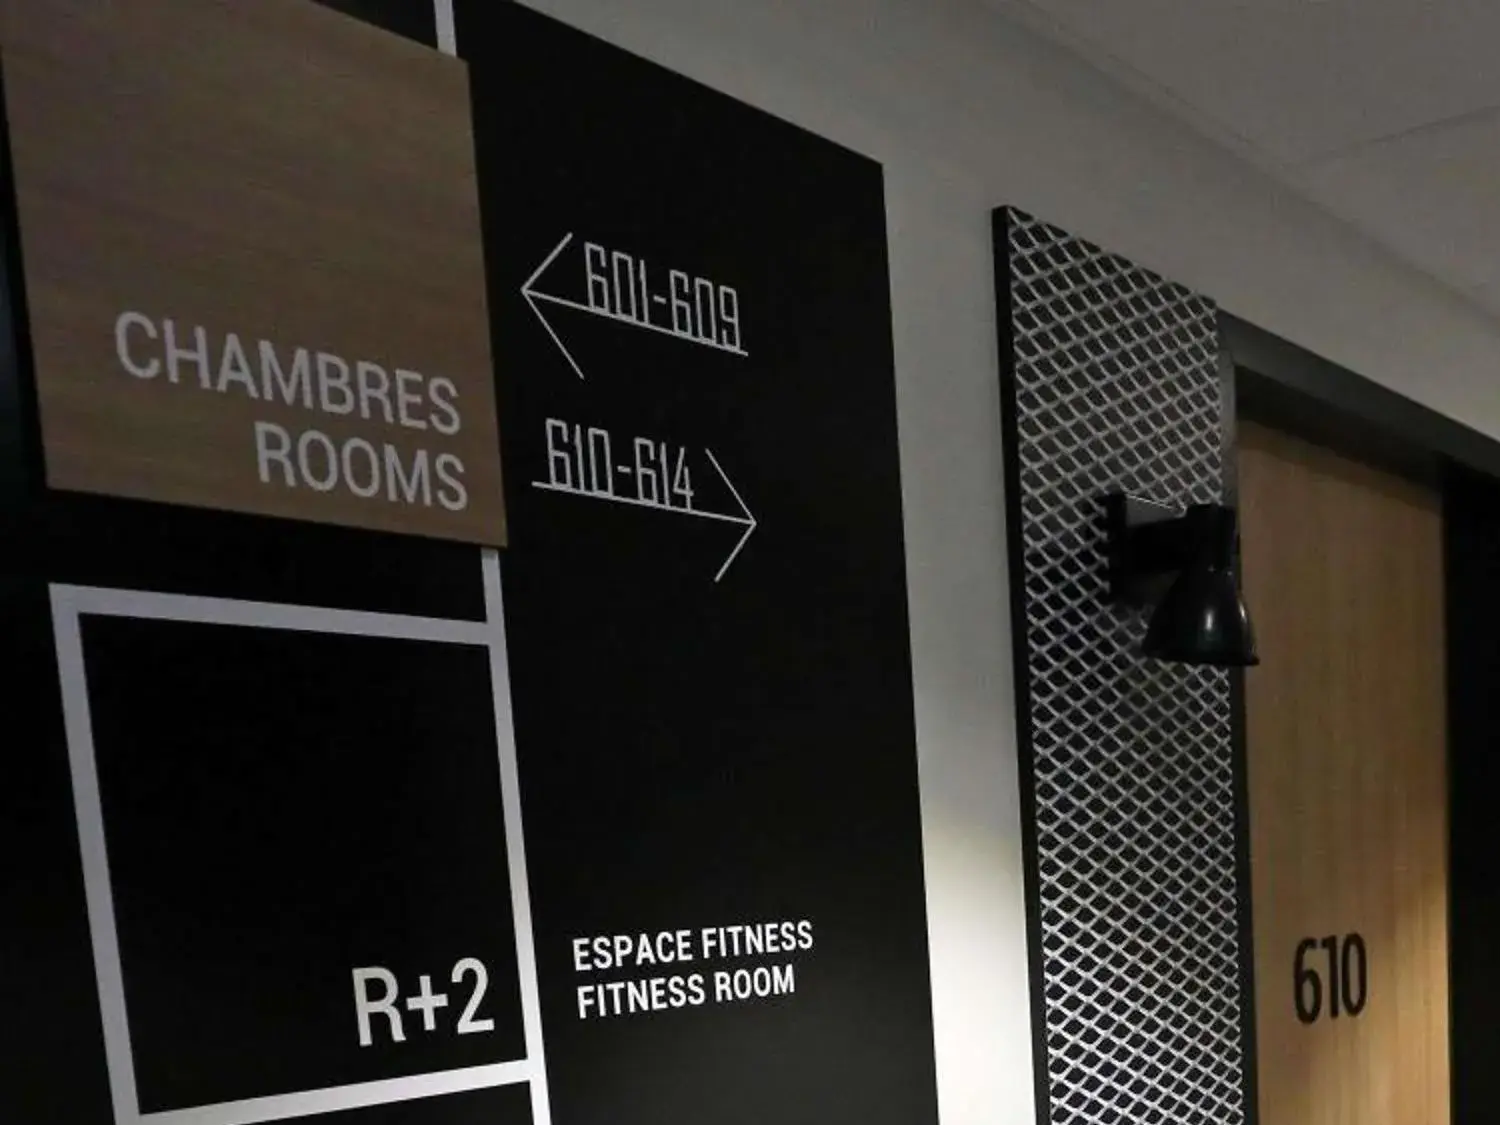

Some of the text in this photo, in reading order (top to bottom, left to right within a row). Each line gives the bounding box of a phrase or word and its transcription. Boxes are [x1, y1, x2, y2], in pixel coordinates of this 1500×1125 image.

[584, 242, 744, 355] 601-609
[114, 311, 461, 435] CHAMBRES
[254, 420, 468, 511] ROOMS
[546, 418, 696, 511] 610-614
[572, 919, 814, 971] ESPACE FITNESS
[577, 963, 796, 1019] FITNESS ROOM
[1292, 932, 1367, 1025] 610
[352, 957, 495, 1047] R+2
